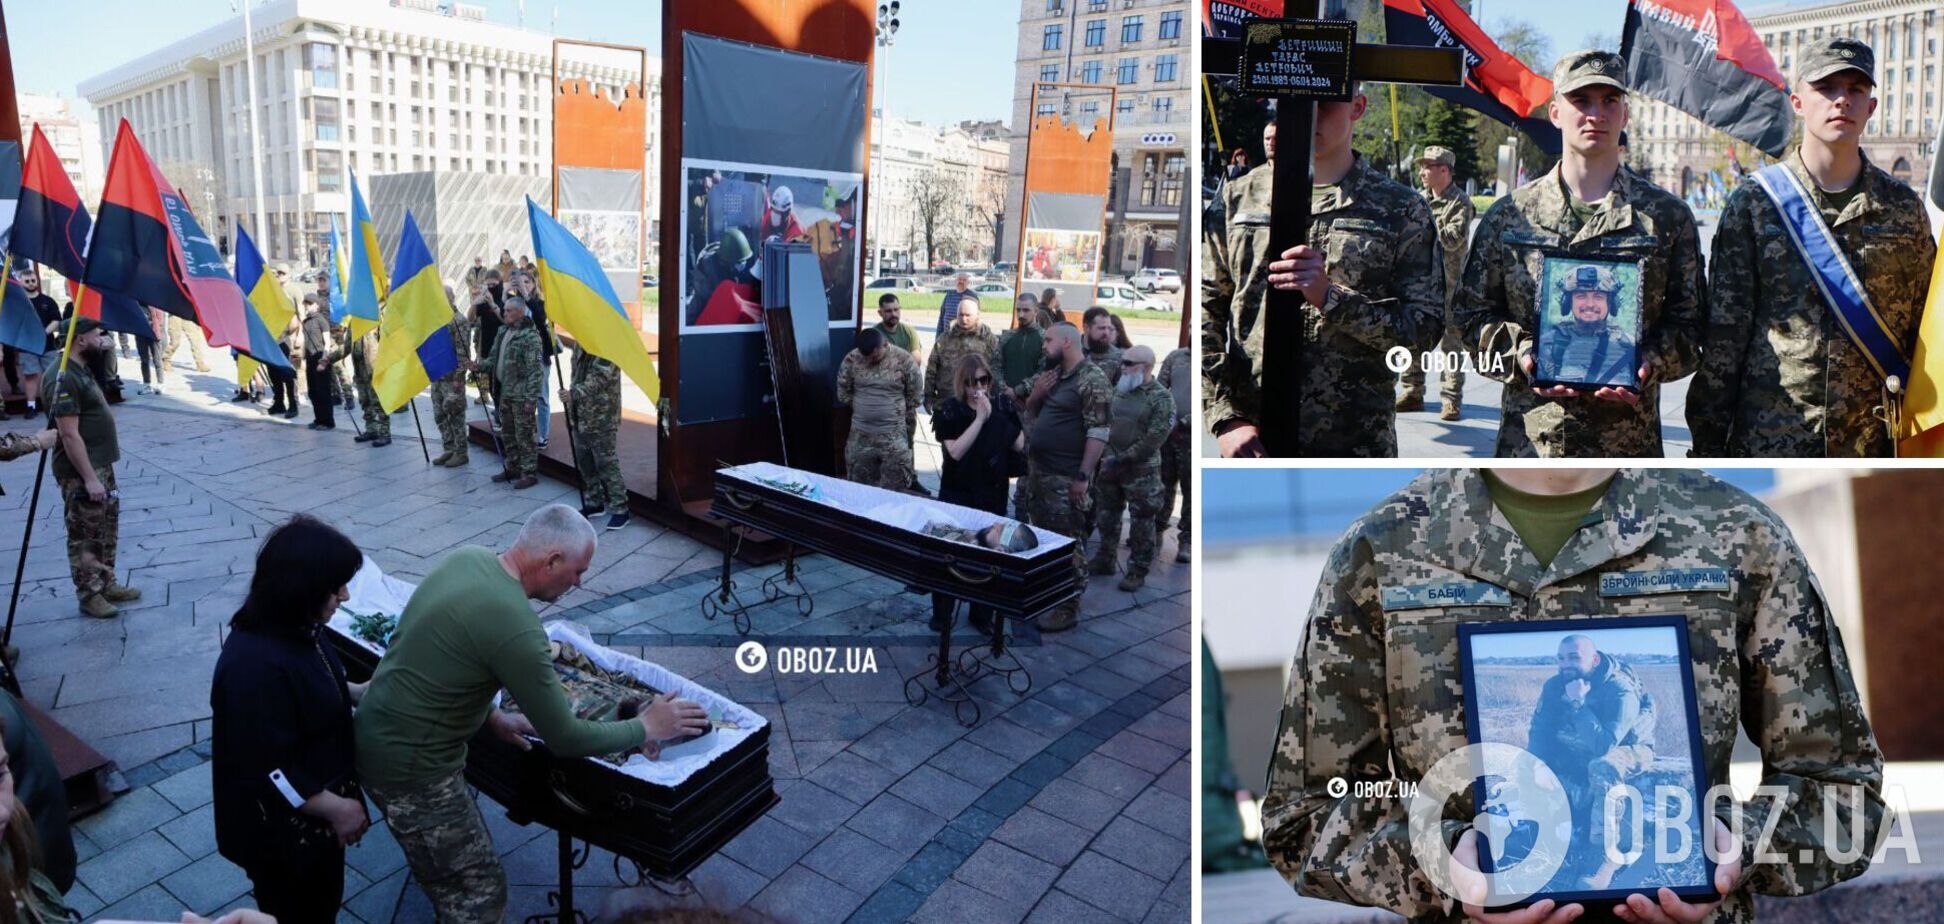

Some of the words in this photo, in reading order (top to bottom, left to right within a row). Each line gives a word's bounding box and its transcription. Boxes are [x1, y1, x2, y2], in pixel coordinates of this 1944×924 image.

[1250, 2, 1281, 18] СЕКТО
[1271, 52, 1306, 62] ТАРАС
[1602, 576, 1648, 589] ЗБРОЙНІ
[1651, 574, 1680, 586] СИЛИ
[1681, 572, 1727, 584] УКРАЇНИ
[1428, 585, 1466, 599] БАБІЙ
